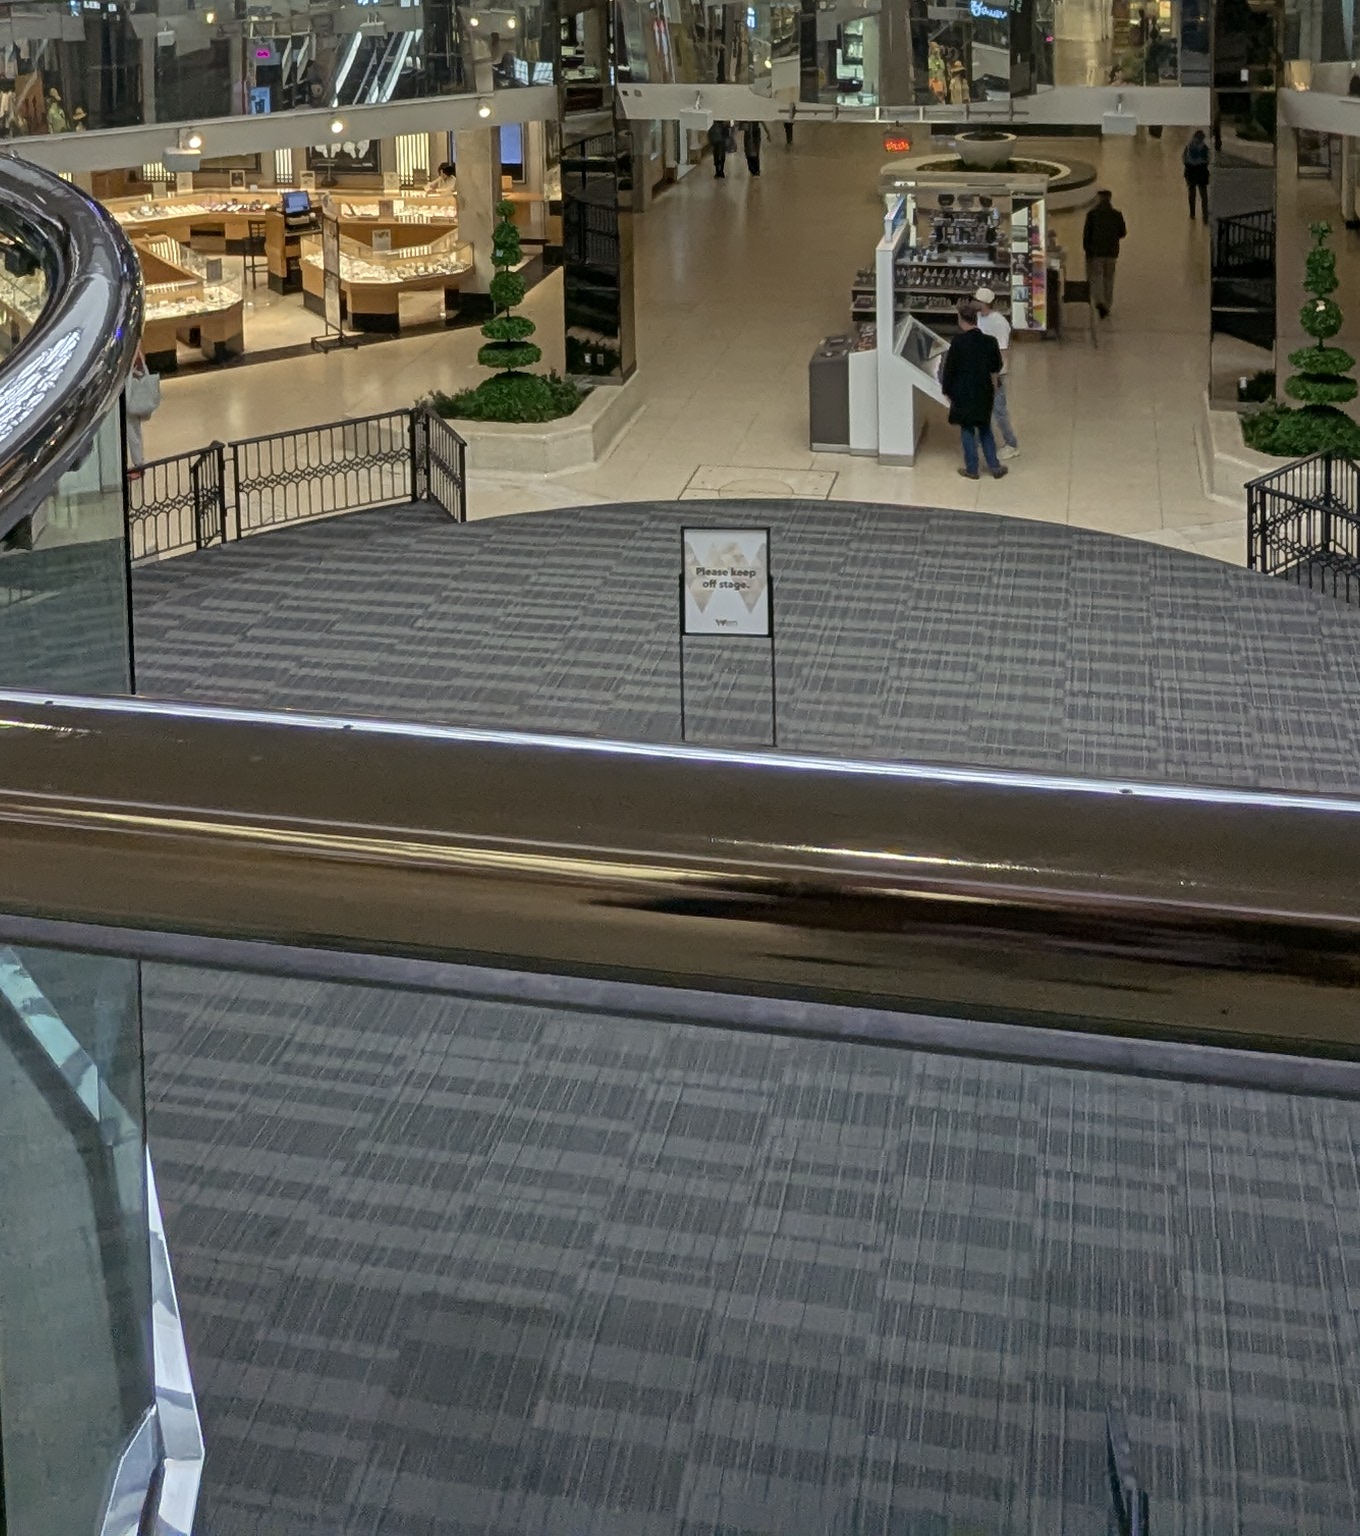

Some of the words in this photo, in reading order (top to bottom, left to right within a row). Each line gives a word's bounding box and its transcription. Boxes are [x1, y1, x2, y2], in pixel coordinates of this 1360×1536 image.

[696, 567, 728, 577] Please
[731, 567, 756, 578] keep
[702, 579, 717, 589] off
[719, 580, 751, 591] stage.
